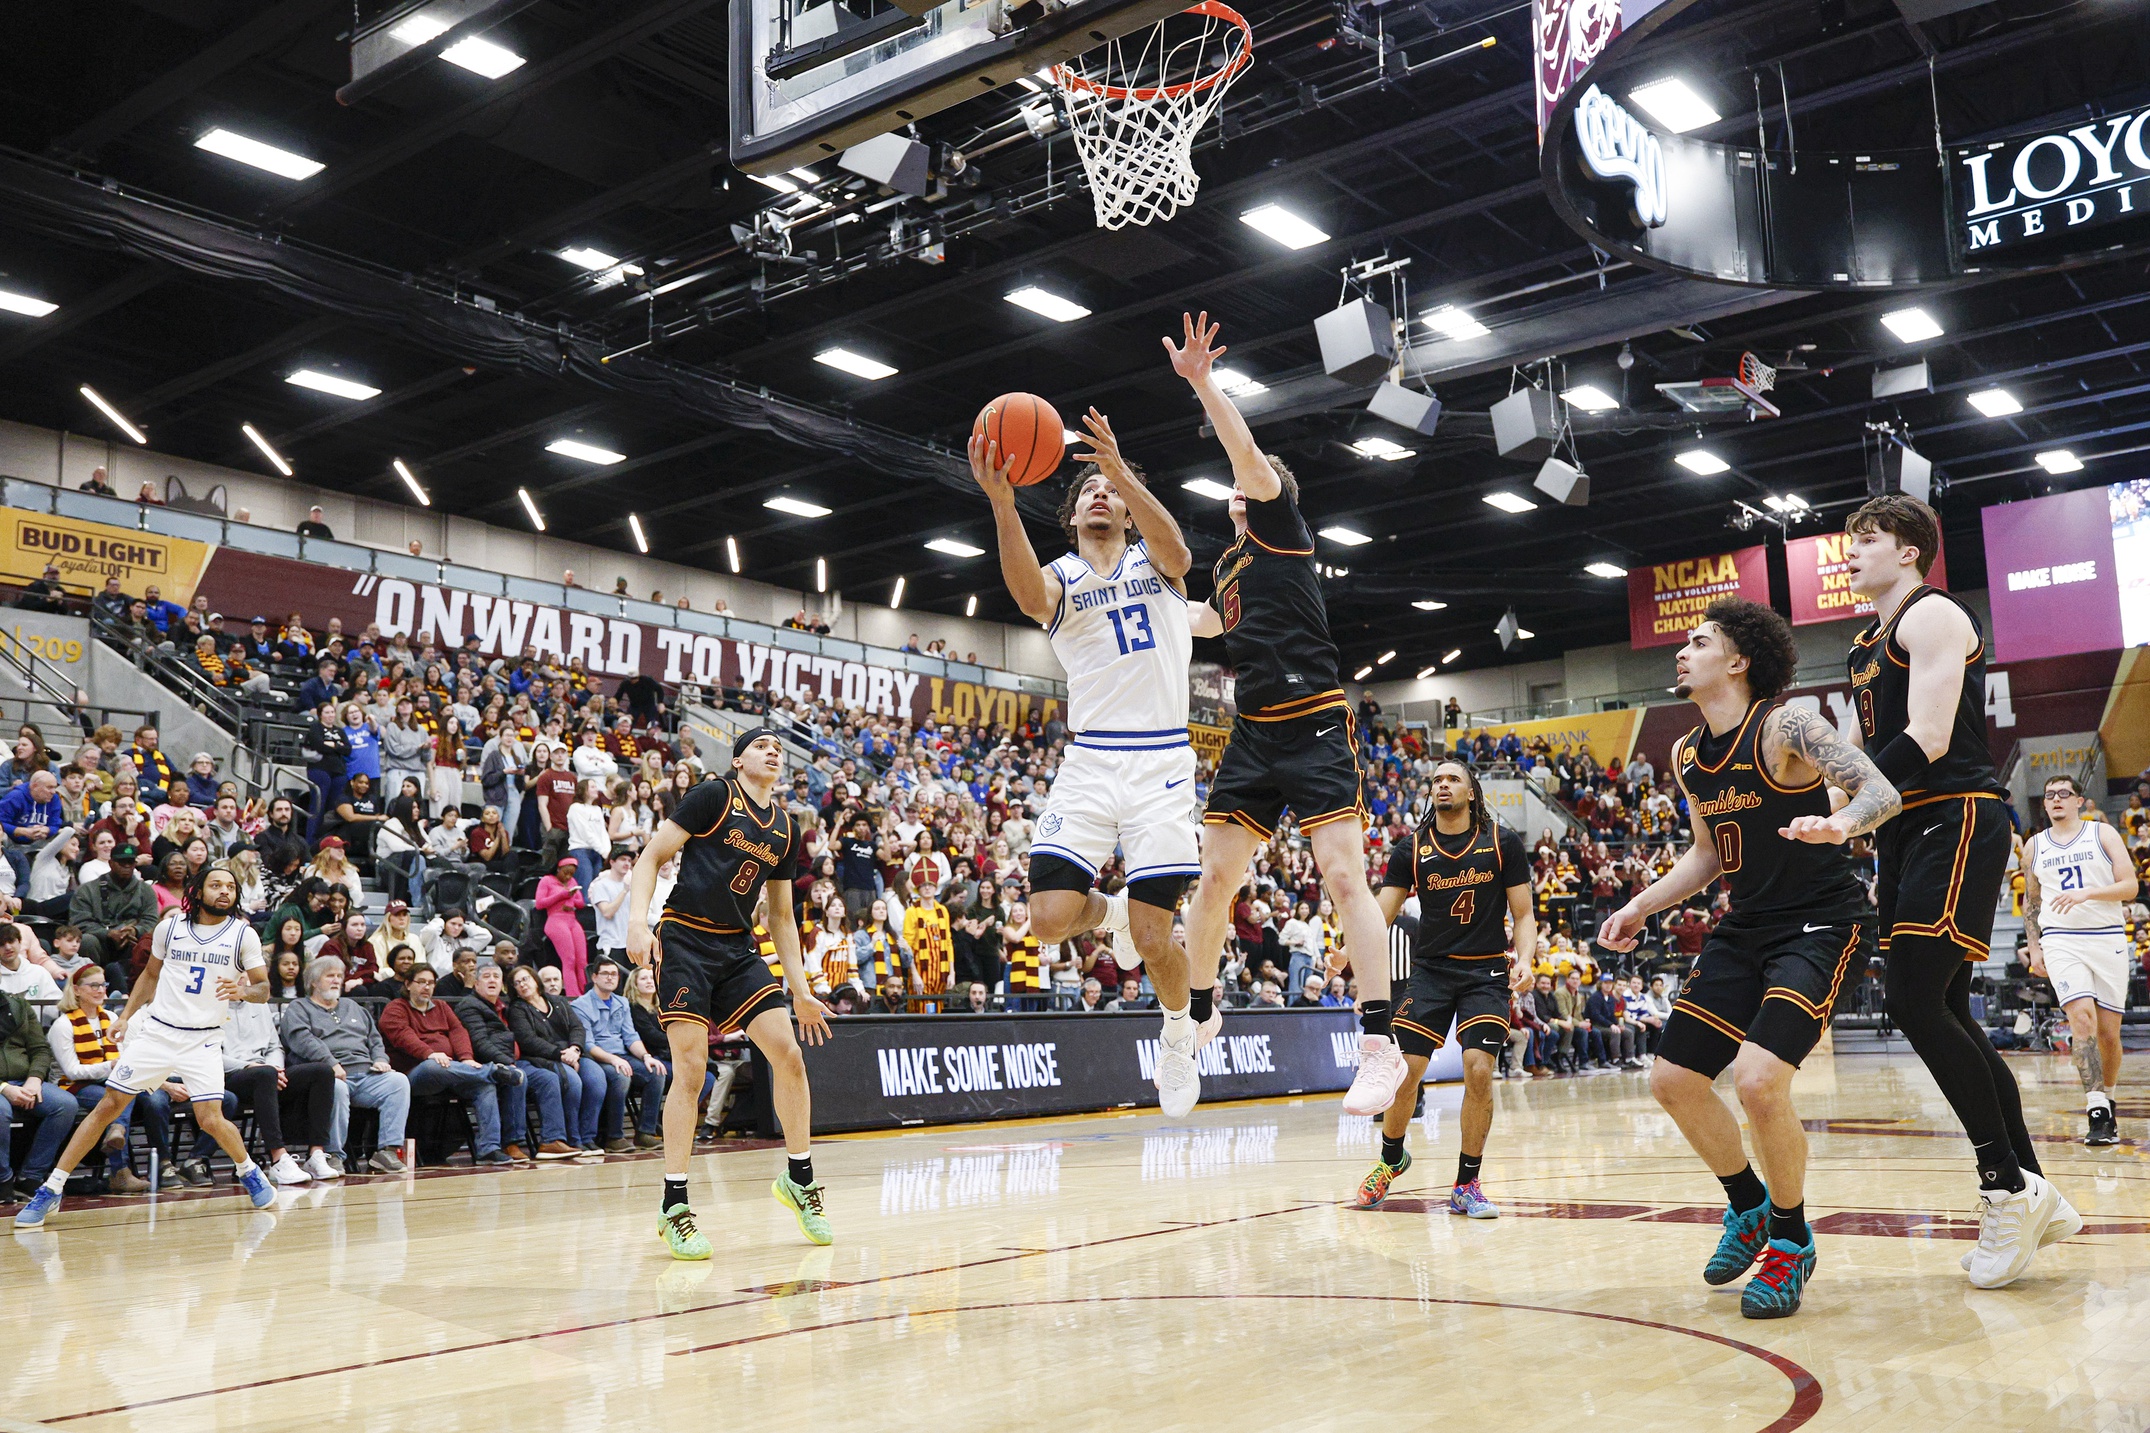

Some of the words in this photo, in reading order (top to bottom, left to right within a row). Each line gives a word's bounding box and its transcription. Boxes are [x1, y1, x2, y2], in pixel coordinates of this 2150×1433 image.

[22, 526, 81, 553] BUD
[85, 537, 162, 567] LIGHT
[46, 553, 99, 574] Loyola
[100, 562, 132, 579] LOFT
[1653, 554, 1739, 592] NCAA
[2007, 567, 2051, 592] MAKE
[2052, 560, 2097, 585] NOISE
[1071, 586, 1117, 612] SAINT
[1123, 577, 1162, 598] LOUIS
[1223, 579, 1242, 633] 5
[1654, 590, 1682, 601] MEN'S
[1684, 581, 1740, 597] VOLLEYBALL
[1106, 603, 1156, 656] 13
[27, 635, 83, 663] 209
[657, 628, 722, 684] TO
[736, 642, 919, 718] VICTORY
[1860, 689, 1876, 737] 9
[1196, 732, 1228, 749] LIGHT
[1547, 729, 1592, 746] BANK
[1500, 793, 1523, 806] 211
[724, 829, 779, 867] Ramblers
[1472, 847, 1494, 855] A10
[1715, 821, 1742, 874] 0
[2042, 855, 2066, 869] SAINT
[2068, 851, 2094, 863] LOUIS
[730, 860, 760, 896] 8
[1427, 867, 1494, 892] Ramblers
[2058, 865, 2084, 891] 21
[1451, 890, 1475, 925] 4
[171, 949, 199, 963] SAINT
[202, 951, 230, 966] LOUIS
[185, 966, 206, 995] 3
[668, 986, 689, 1009] L
[877, 1047, 943, 1097] MAKE
[943, 1045, 1003, 1093] SOME
[1002, 1043, 1062, 1089] NOISE
[1228, 1035, 1275, 1075] NOISE
